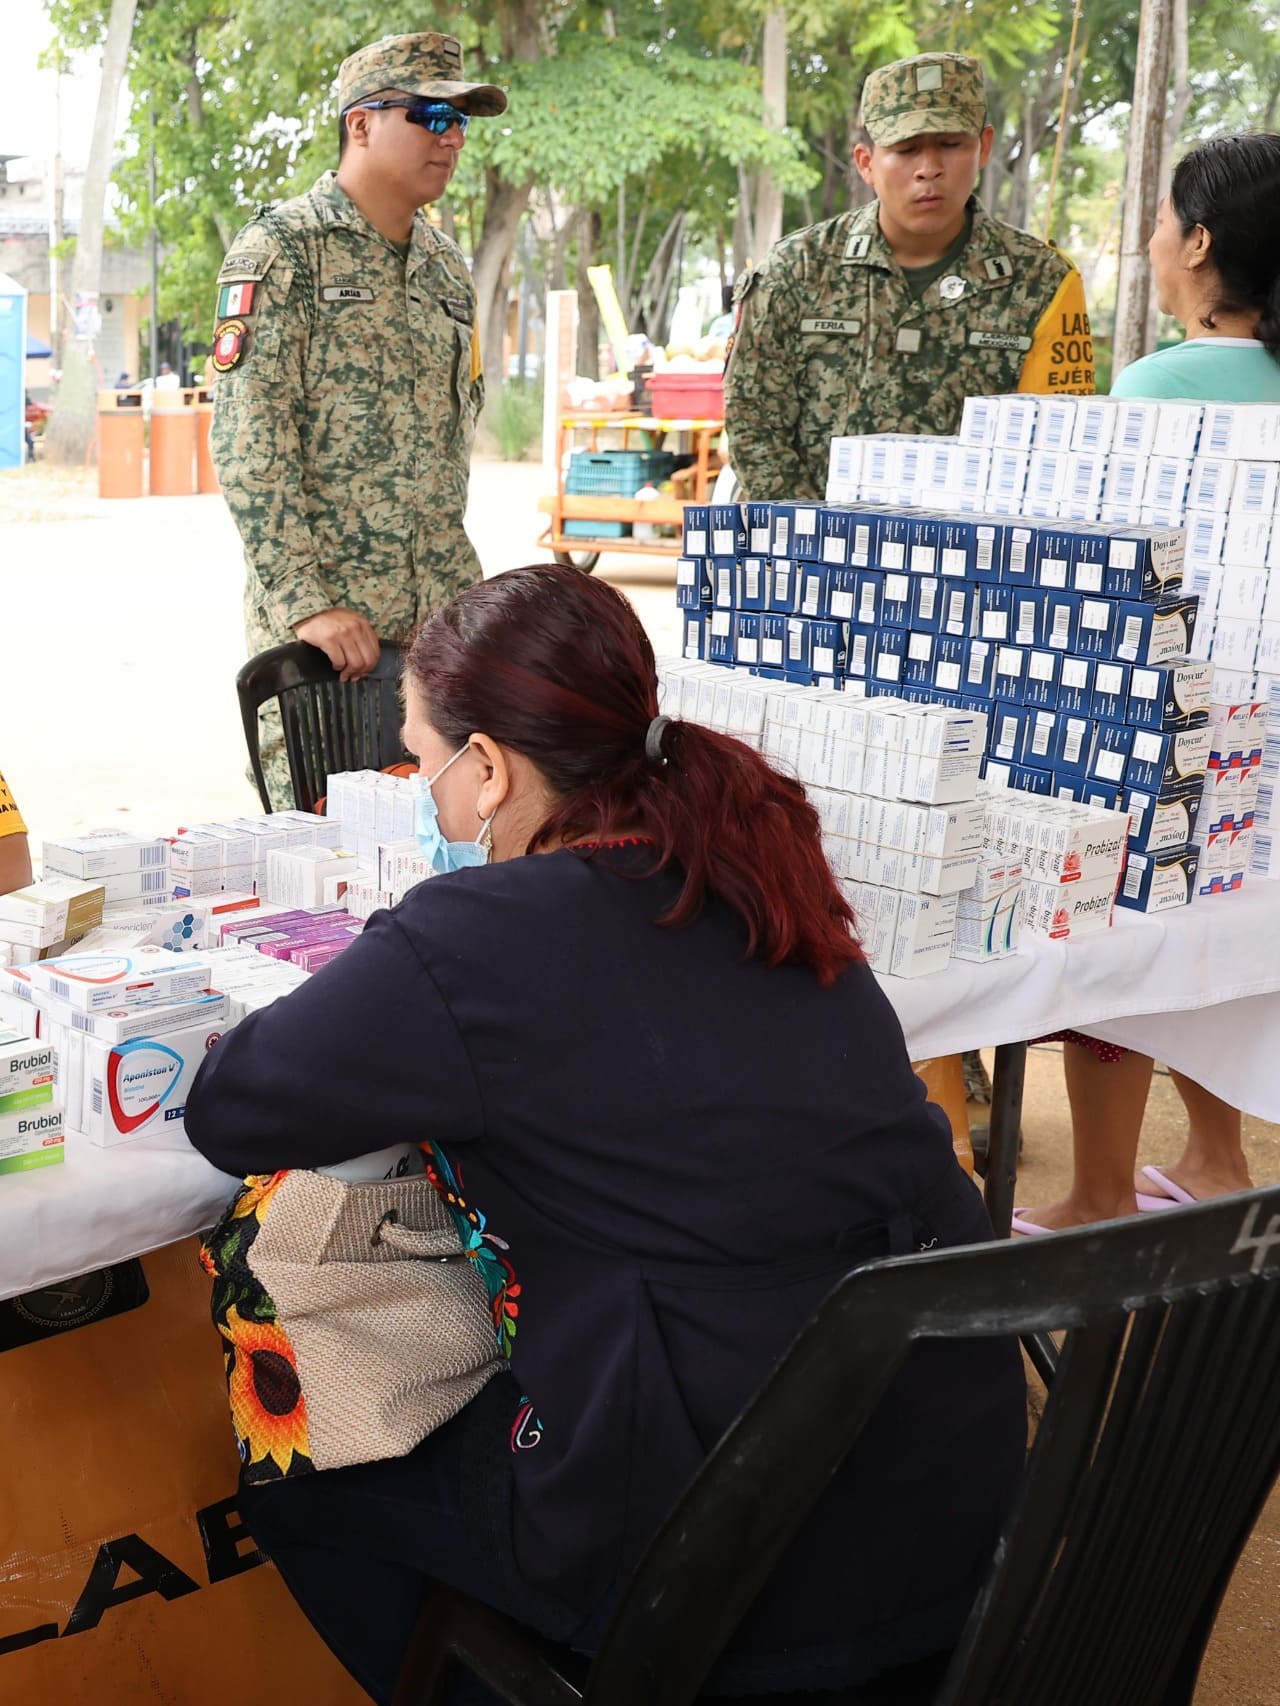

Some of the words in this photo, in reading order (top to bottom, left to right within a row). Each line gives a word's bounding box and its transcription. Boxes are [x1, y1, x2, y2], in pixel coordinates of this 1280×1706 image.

[339, 289, 362, 298] ARIAS
[814, 321, 846, 331] FERIA
[1062, 312, 1091, 336] LAB
[1051, 340, 1094, 364] SOC
[0, 788, 8, 797] Y
[1084, 838, 1122, 857] Probizal
[1073, 895, 1110, 915] Probizal
[10, 1050, 52, 1073] Brubiol
[169, 1063, 176, 1072] V
[18, 1112, 62, 1134] Brubiol
[167, 1110, 177, 1119] 12
